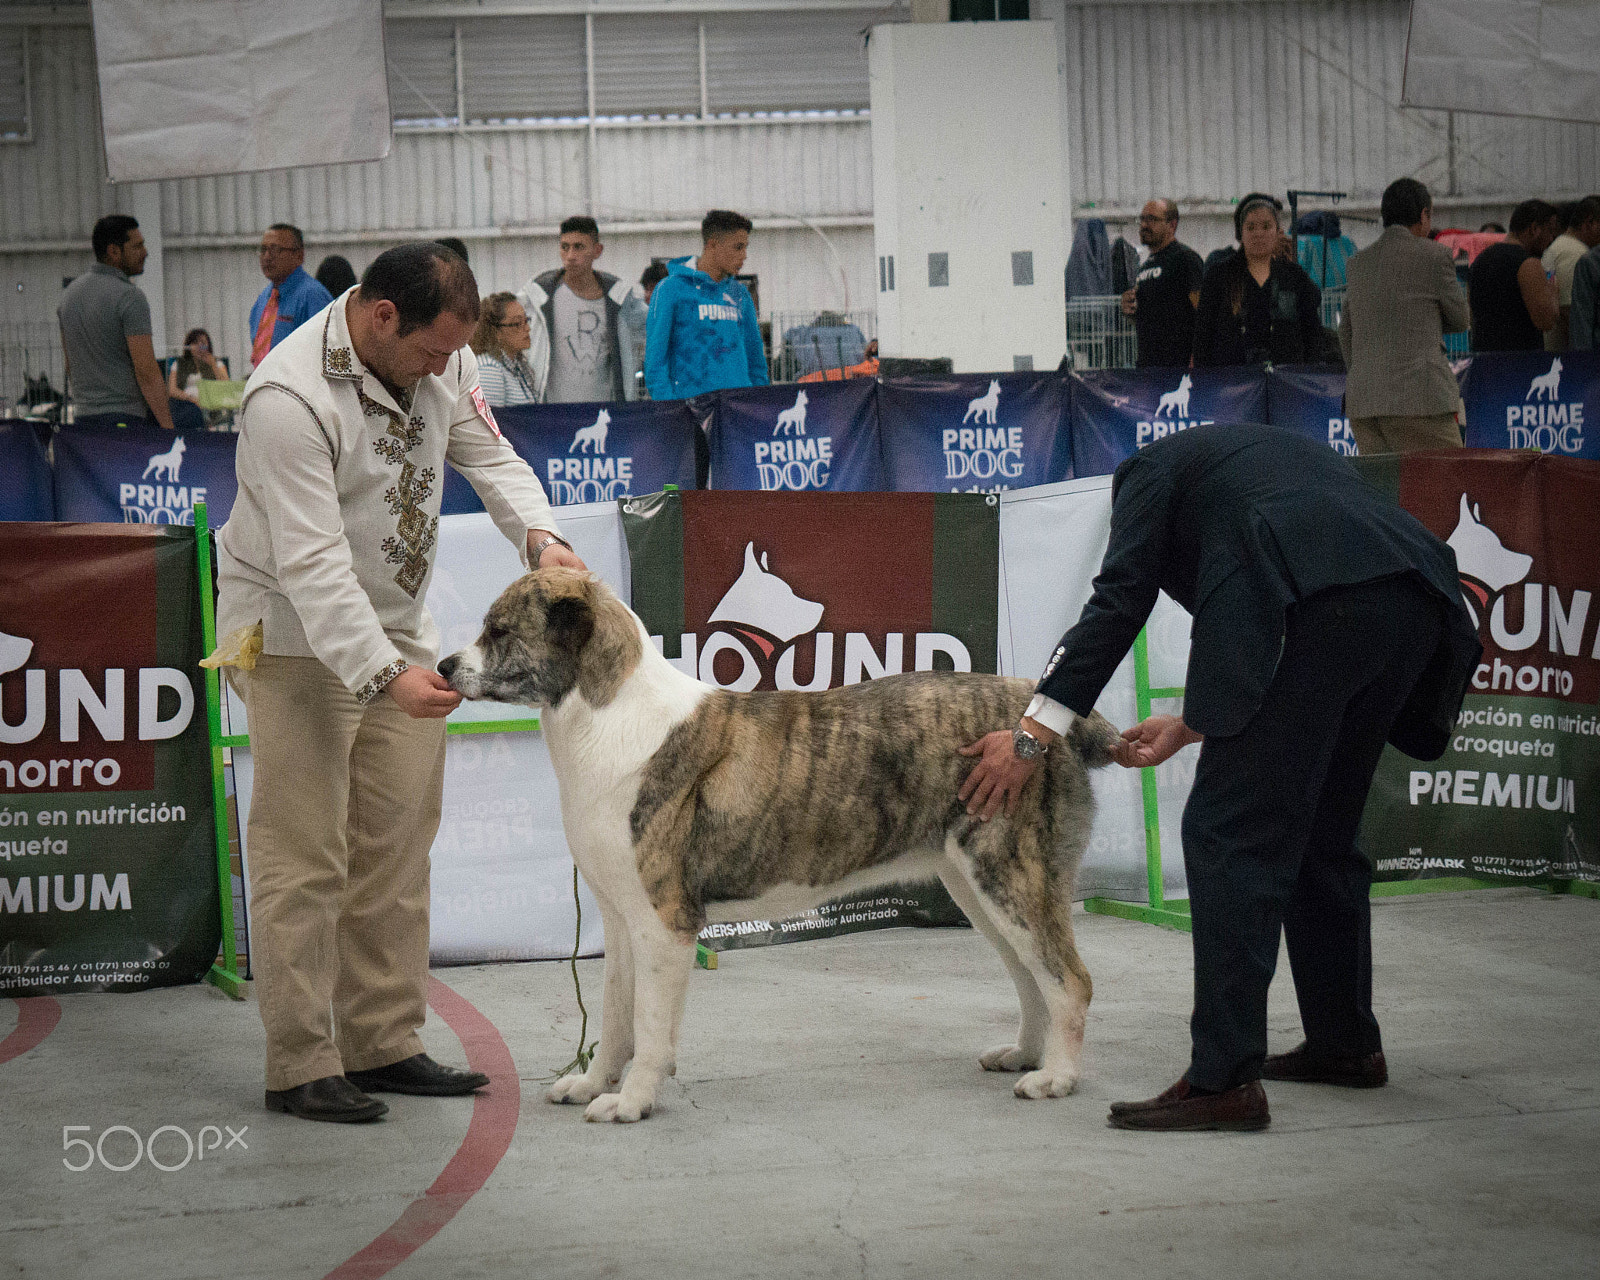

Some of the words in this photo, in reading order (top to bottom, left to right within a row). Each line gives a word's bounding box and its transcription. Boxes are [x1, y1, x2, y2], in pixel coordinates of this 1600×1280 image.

[1506, 403, 1584, 426] PRIME
[943, 427, 1024, 450] PRIME
[1136, 421, 1214, 441] PRI
[1507, 423, 1584, 453] DOG
[755, 437, 833, 464] PRIME
[547, 457, 633, 481] PRIME
[756, 459, 831, 491] DOG
[943, 449, 1024, 479] DOG
[120, 483, 207, 508] PRIME
[1529, 713, 1555, 729] en
[1453, 735, 1555, 758] croqueta
[36, 809, 68, 826] en
[76, 802, 186, 825] nutrición
[780, 916, 838, 933] Distribuidor
[840, 907, 899, 925] Autorizado
[24, 965, 40, 974] 791
[42, 964, 55, 972] 25
[57, 963, 70, 971] 46
[80, 962, 93, 970] 01
[96, 961, 119, 970] (771)
[143, 960, 156, 969] 03
[73, 971, 150, 984] Autorizado
